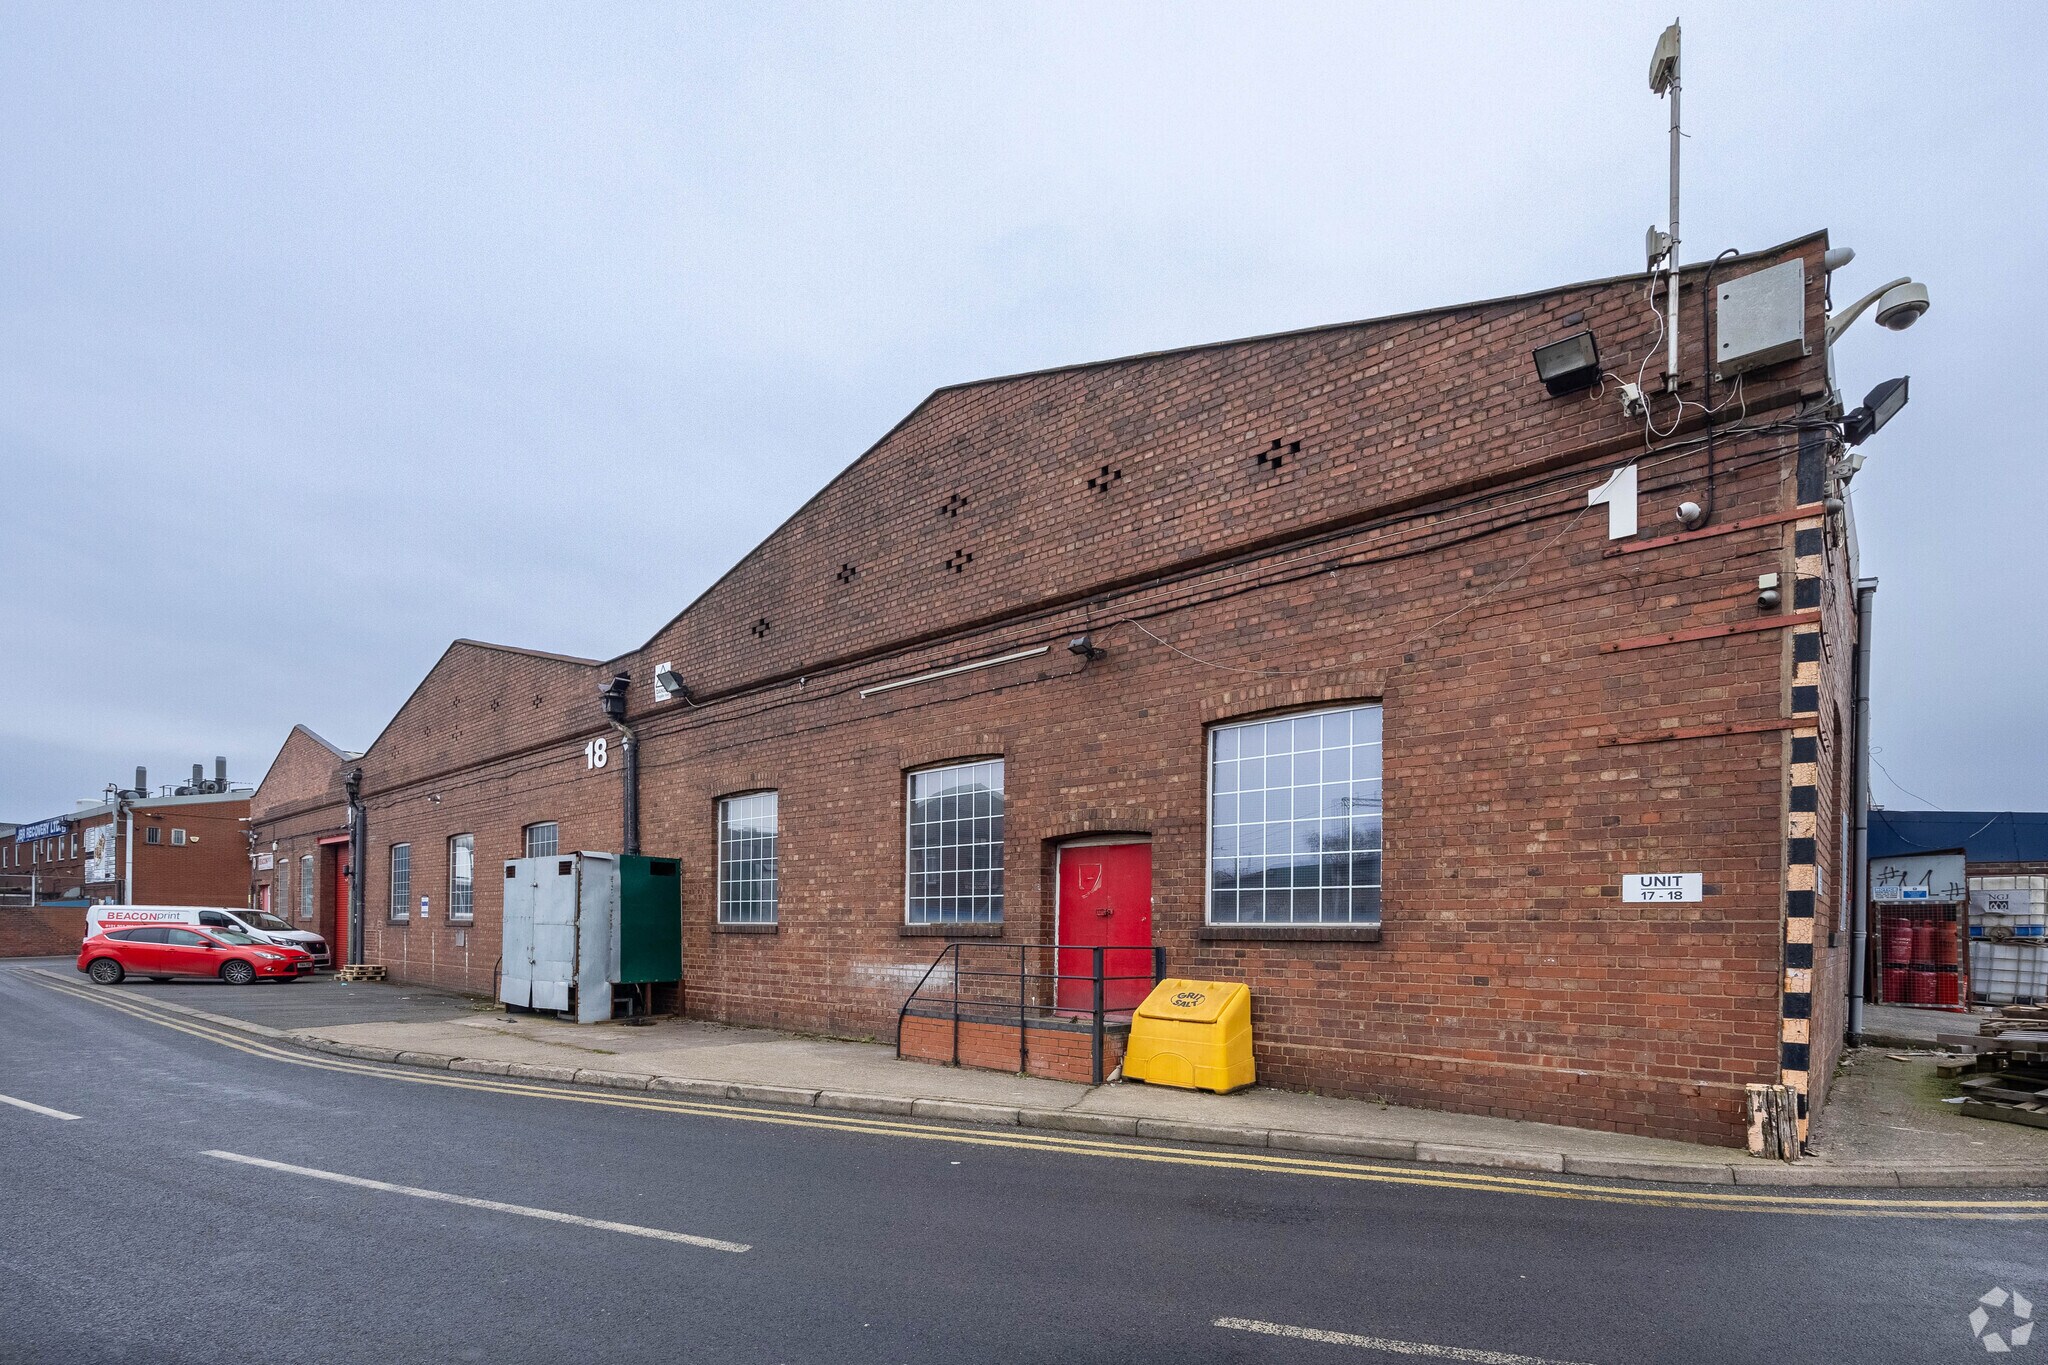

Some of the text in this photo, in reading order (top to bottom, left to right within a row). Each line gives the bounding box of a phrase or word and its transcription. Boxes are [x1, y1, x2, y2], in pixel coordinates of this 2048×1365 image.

[1588, 464, 1638, 540] 1
[584, 738, 608, 770] 18
[1640, 875, 1683, 887] UNIT
[1640, 891, 1655, 900] 17
[1667, 890, 1683, 900] 18
[1177, 992, 1206, 1001] GRIT
[1172, 999, 1199, 1008] SALT
